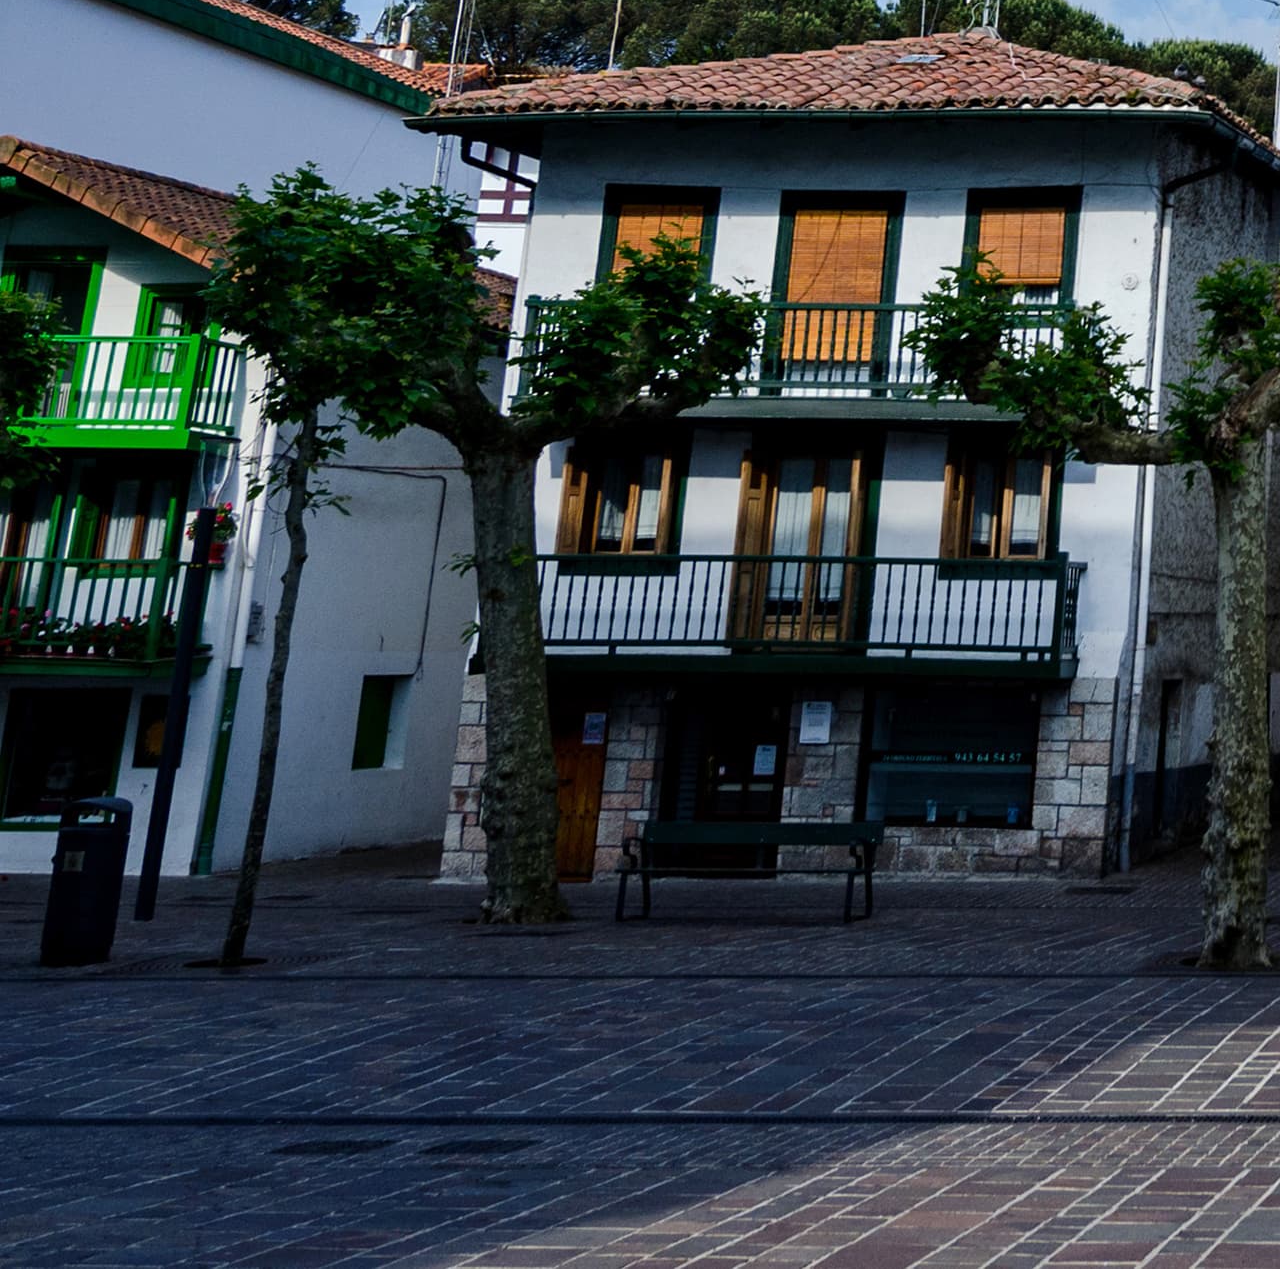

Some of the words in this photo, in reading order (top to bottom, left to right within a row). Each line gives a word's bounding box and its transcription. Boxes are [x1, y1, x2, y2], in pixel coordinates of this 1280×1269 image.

[954, 752, 973, 762] 943
[993, 752, 1005, 762] 54
[1009, 752, 1022, 762] 57
